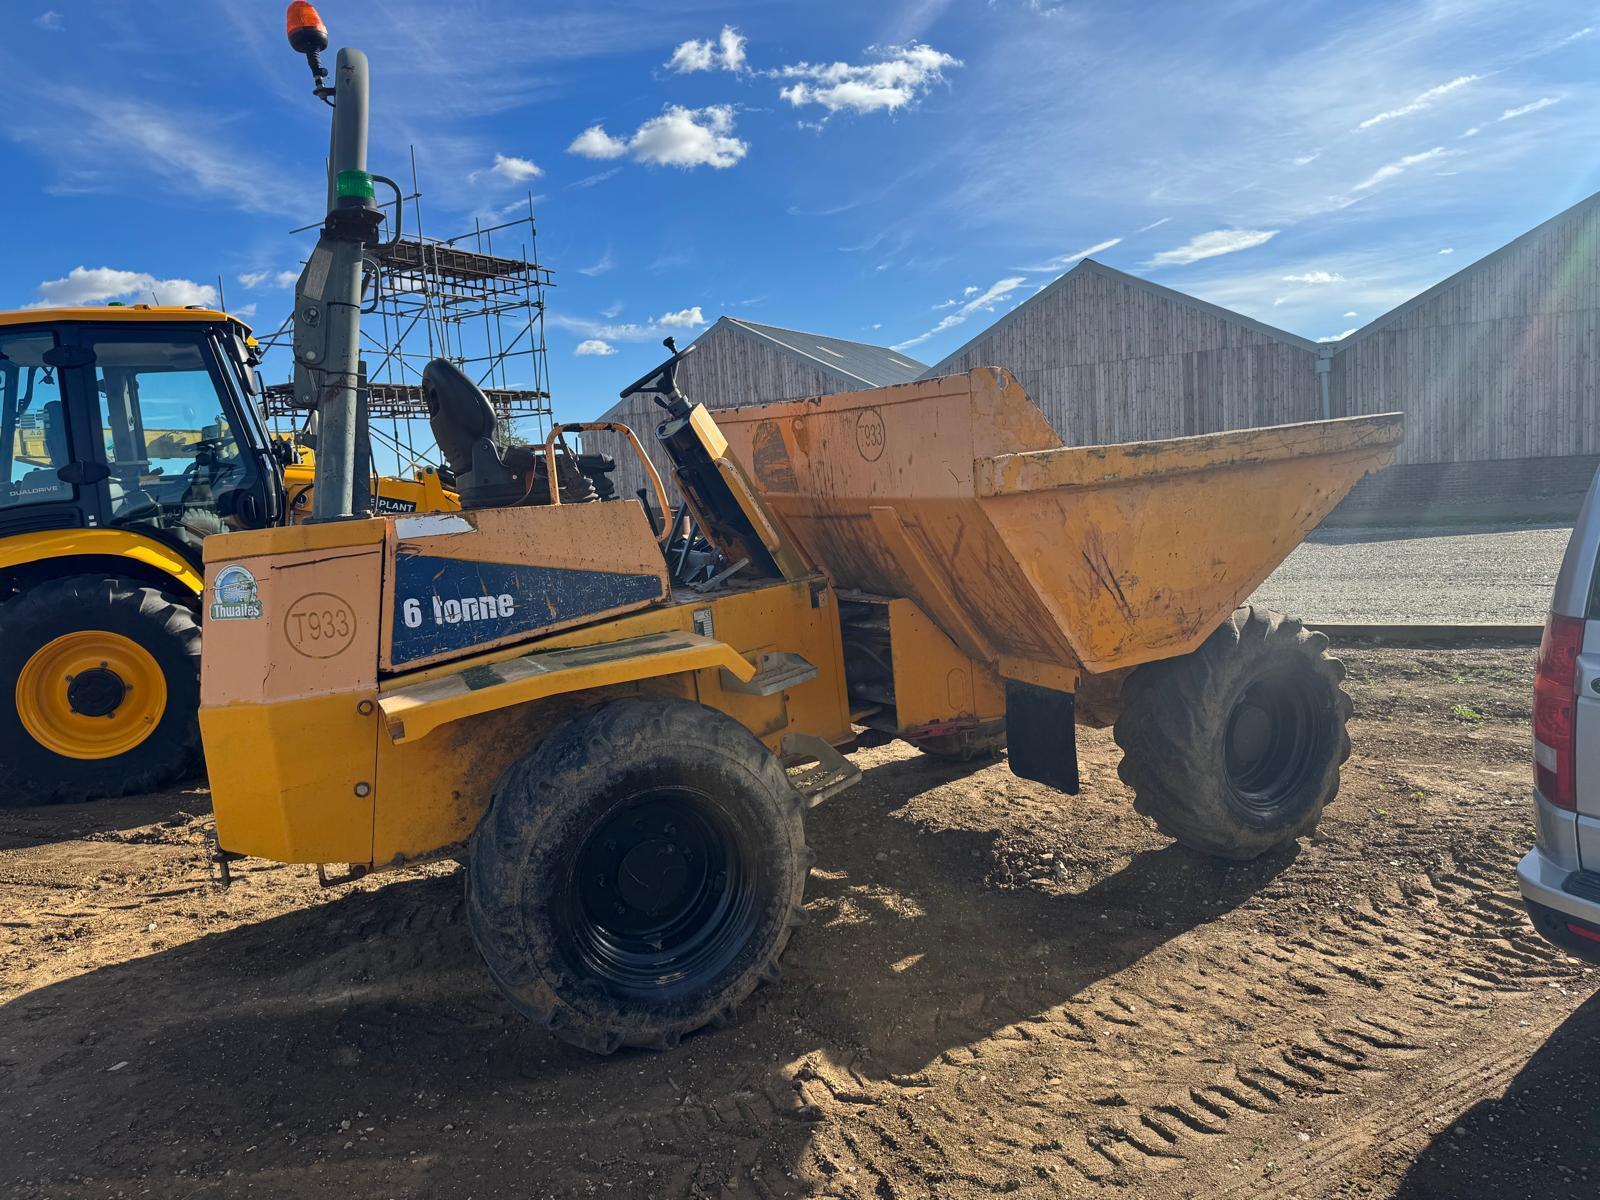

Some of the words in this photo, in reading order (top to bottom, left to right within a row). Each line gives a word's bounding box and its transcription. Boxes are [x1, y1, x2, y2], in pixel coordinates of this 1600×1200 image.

[10, 486, 58, 496] DUALDRIVE
[379, 499, 414, 512] PLANT
[214, 604, 259, 618] Thwaites
[403, 598, 422, 628] 6
[432, 593, 515, 625] tonne
[291, 609, 350, 642] T933
